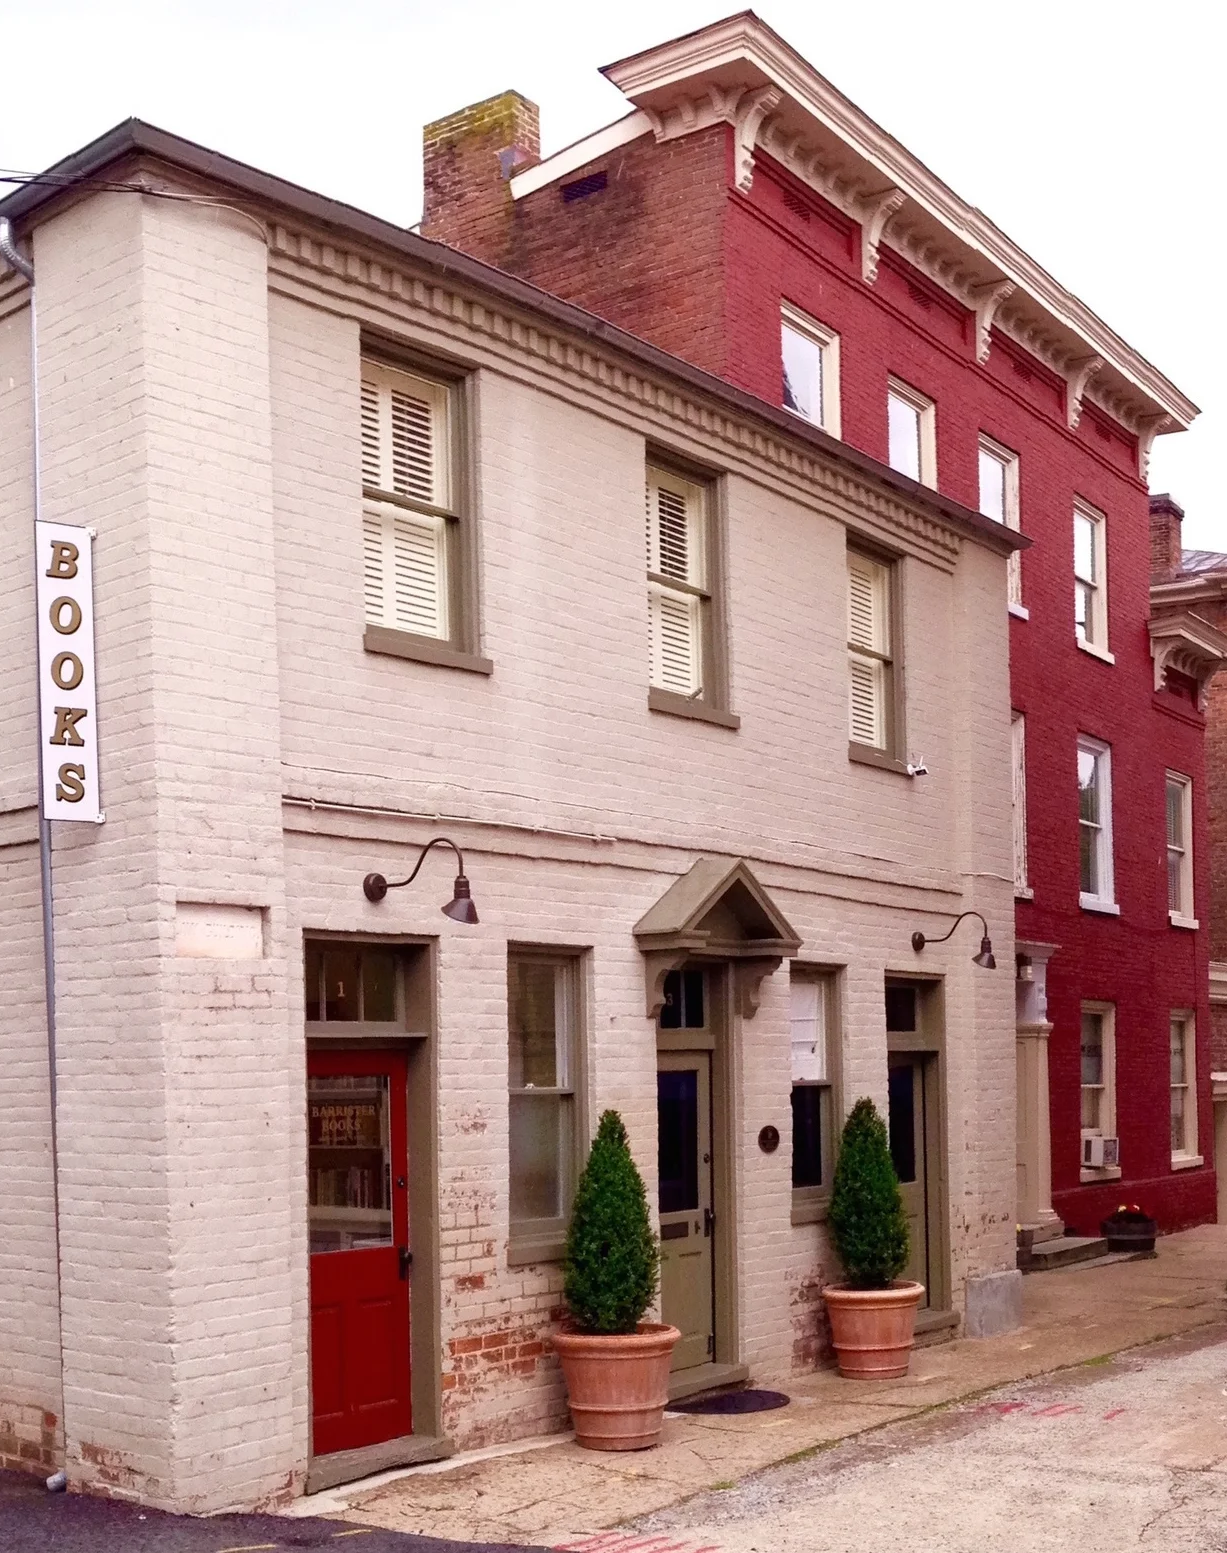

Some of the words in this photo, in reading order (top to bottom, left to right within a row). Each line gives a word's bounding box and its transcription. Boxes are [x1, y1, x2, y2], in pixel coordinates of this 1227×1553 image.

[46, 540, 88, 803] BOOKS
[337, 981, 346, 998] 1
[666, 993, 674, 1006] 3
[311, 1105, 376, 1118] BARRISTER
[321, 1119, 361, 1131] BOOKS
